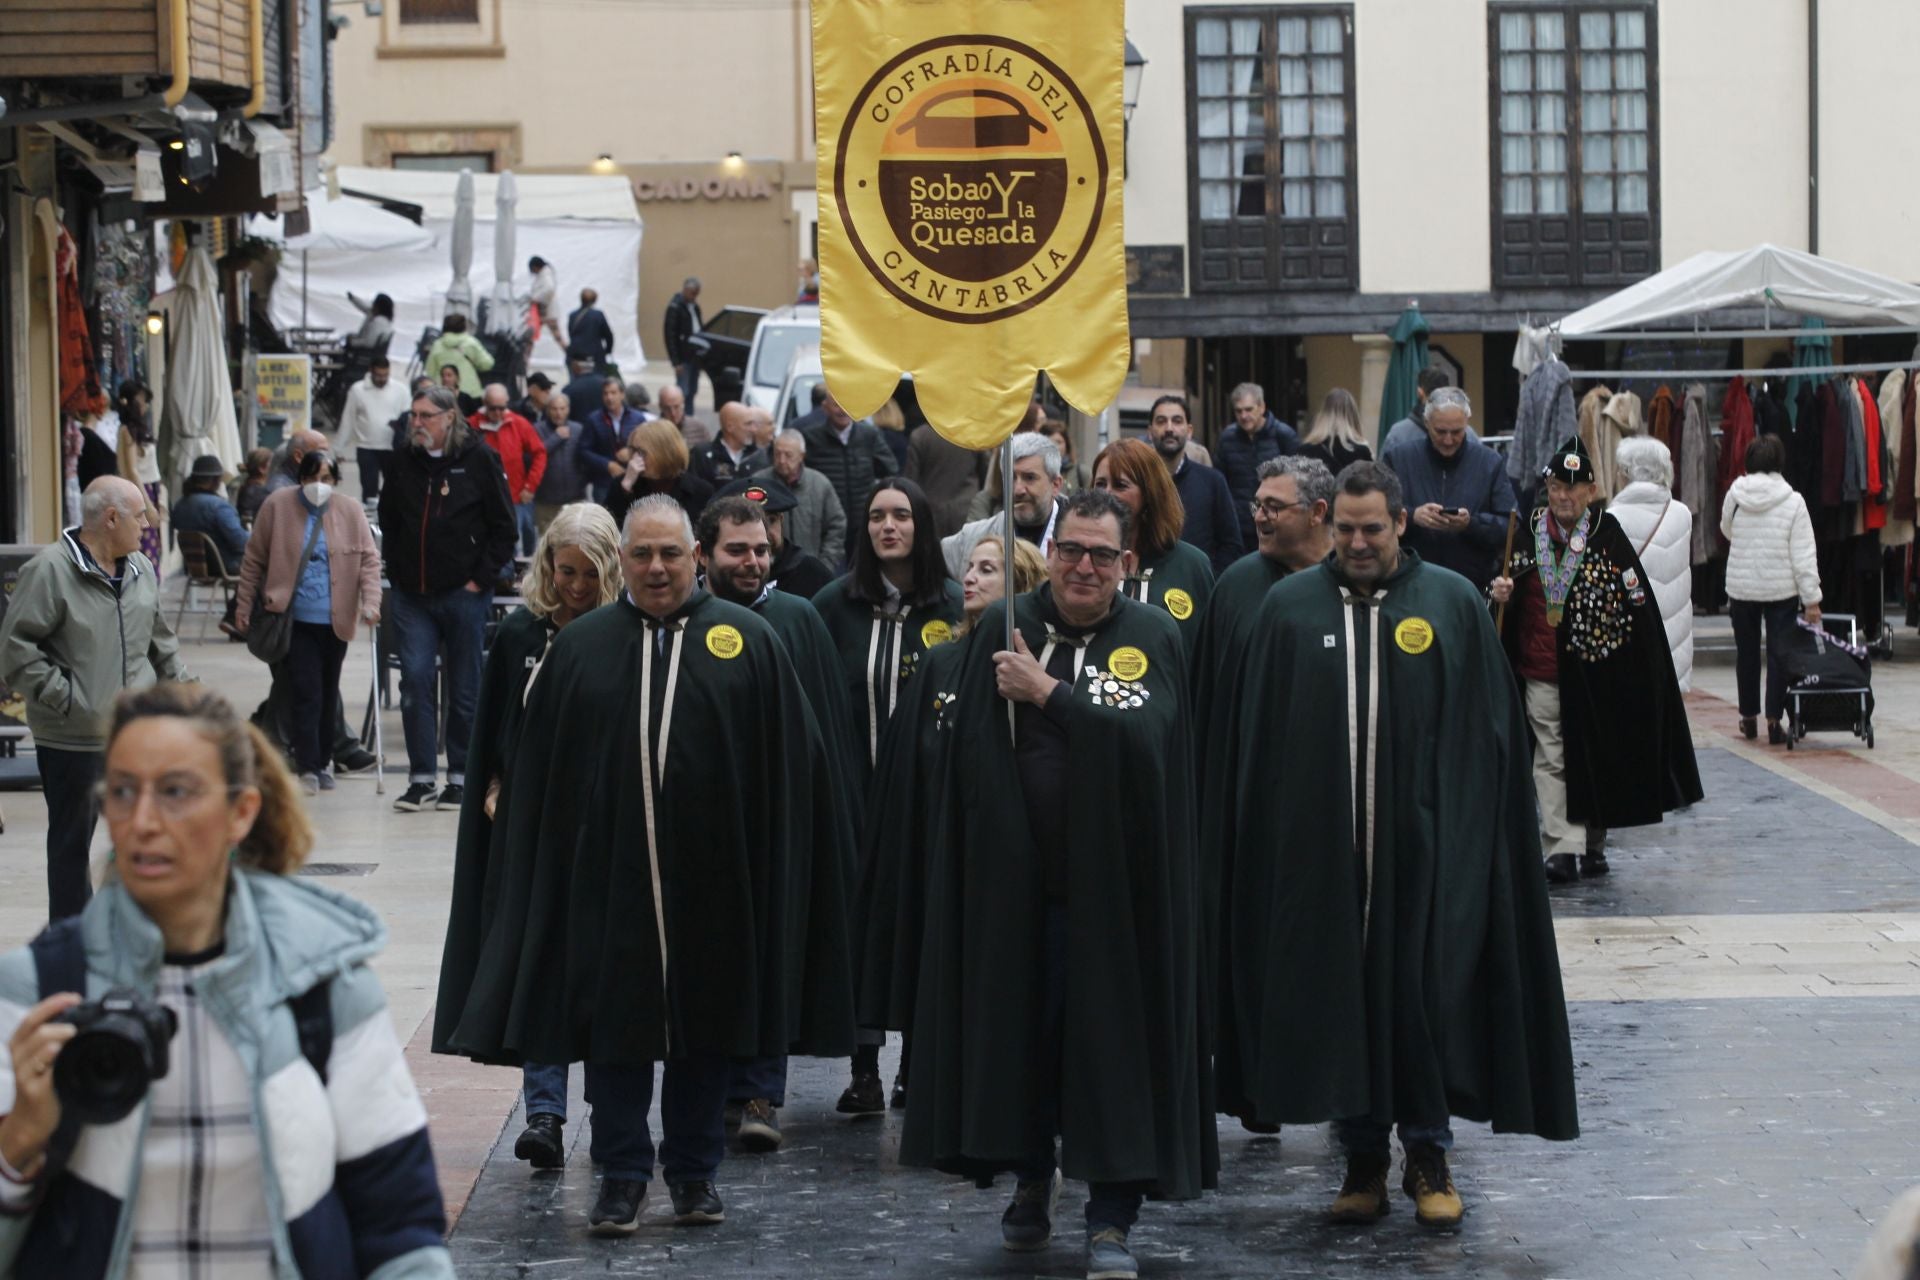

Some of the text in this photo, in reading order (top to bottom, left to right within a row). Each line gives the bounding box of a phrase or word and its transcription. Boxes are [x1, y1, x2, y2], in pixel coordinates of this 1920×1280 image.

[872, 49, 1069, 123] COFRADÍA DEL
[633, 176, 771, 200] CADONA
[910, 171, 1036, 219] Sobao Y
[910, 201, 1036, 224] Pasiego la
[911, 219, 1036, 253] Quesada
